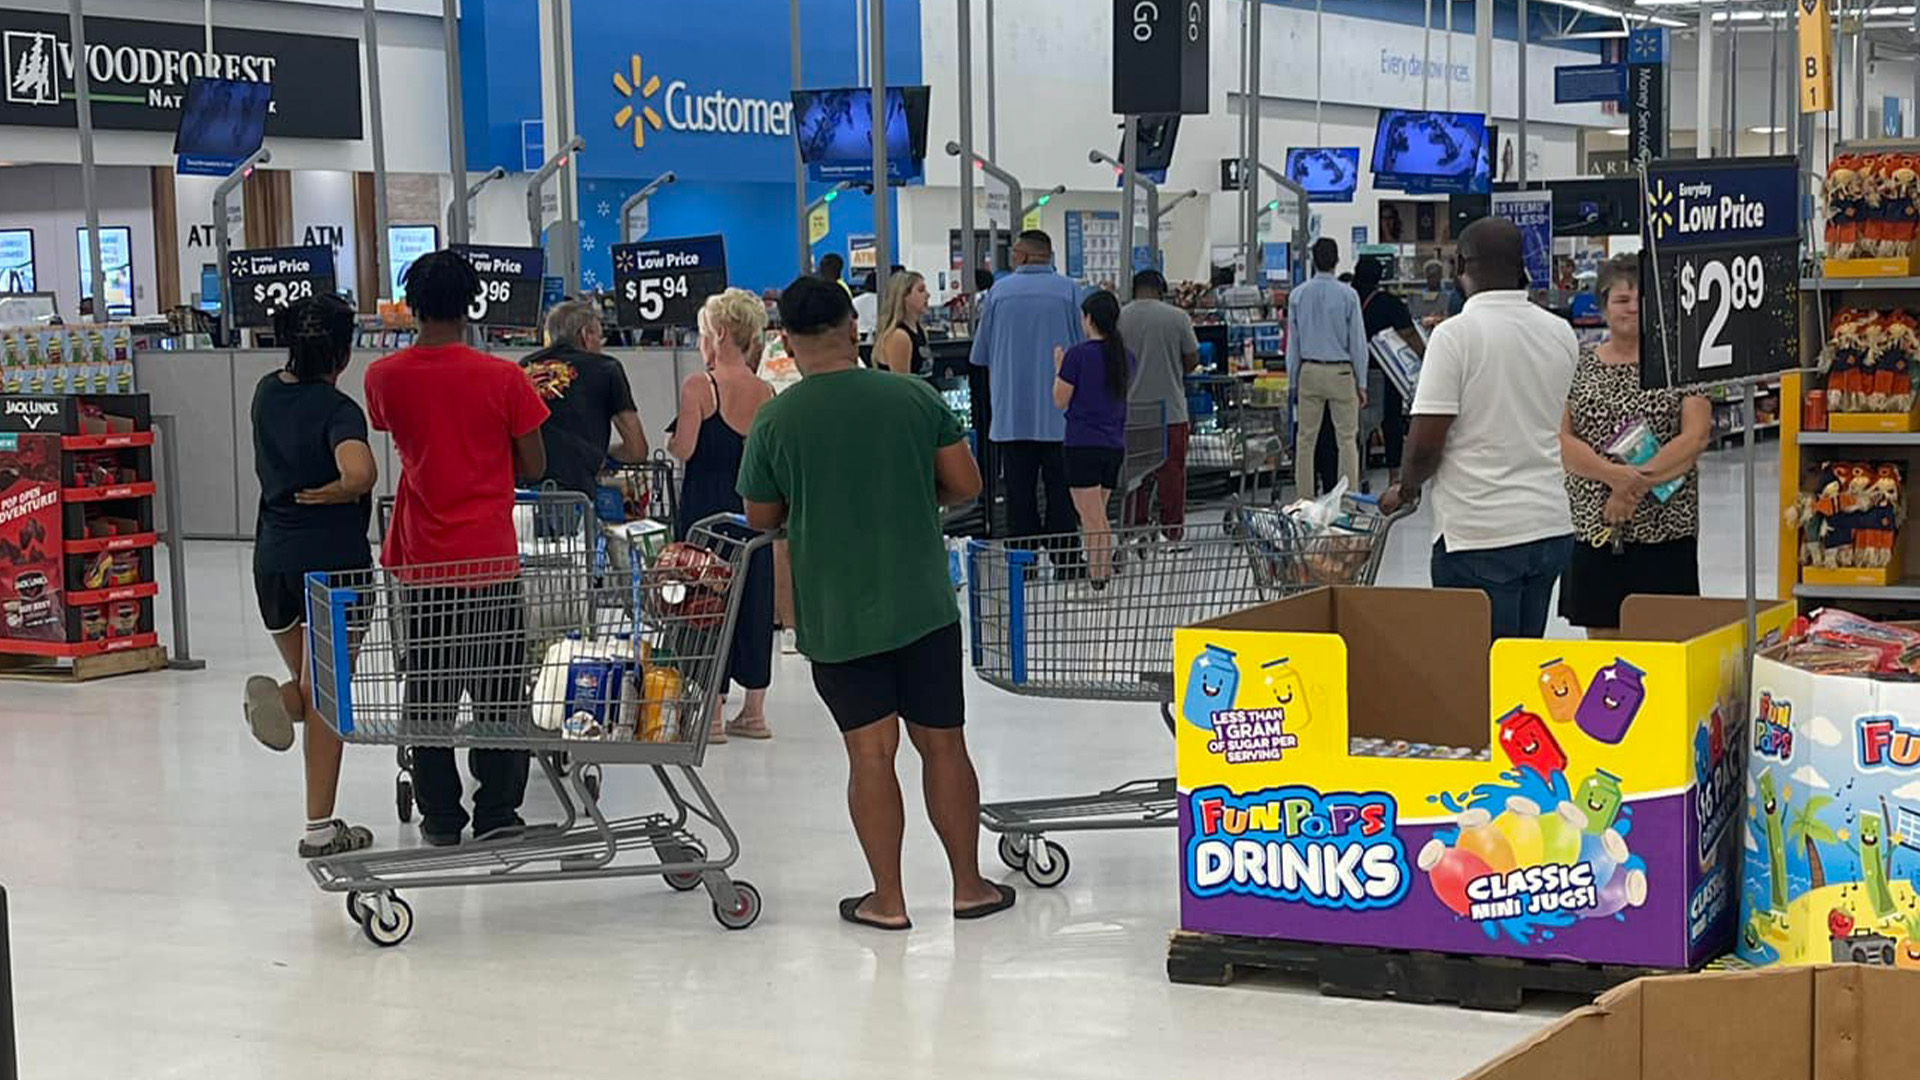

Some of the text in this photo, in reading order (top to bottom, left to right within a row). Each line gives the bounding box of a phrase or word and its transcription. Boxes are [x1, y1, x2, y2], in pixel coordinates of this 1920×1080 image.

[1133, 1, 1159, 41] Go
[57, 42, 276, 85] WOODFOREST
[1806, 56, 1817, 78] B
[1635, 67, 1651, 110] Money
[1810, 86, 1816, 107] 1
[664, 80, 794, 135] Customer
[1678, 182, 1712, 198] Everyday
[1679, 193, 1764, 233] Low Price
[188, 224, 231, 248] AT
[303, 225, 344, 248] ATM
[251, 262, 278, 275] Low
[279, 257, 310, 273] Price
[493, 258, 523, 274] Price
[637, 251, 700, 270] Low Price
[0, 490, 58, 524] DVENTURE!
[1212, 708, 1283, 725] LESS THAN
[1215, 720, 1281, 741] 1 GRAM
[1754, 720, 1792, 760] POPS
[1208, 735, 1297, 752] OF SUGAR PER
[1226, 748, 1280, 762] SERVING
[1862, 720, 1920, 766] FU
[1196, 841, 1400, 900] DRINKS
[1466, 862, 1593, 900] CLASSIC
[1470, 885, 1597, 920] MINI JUGS!
